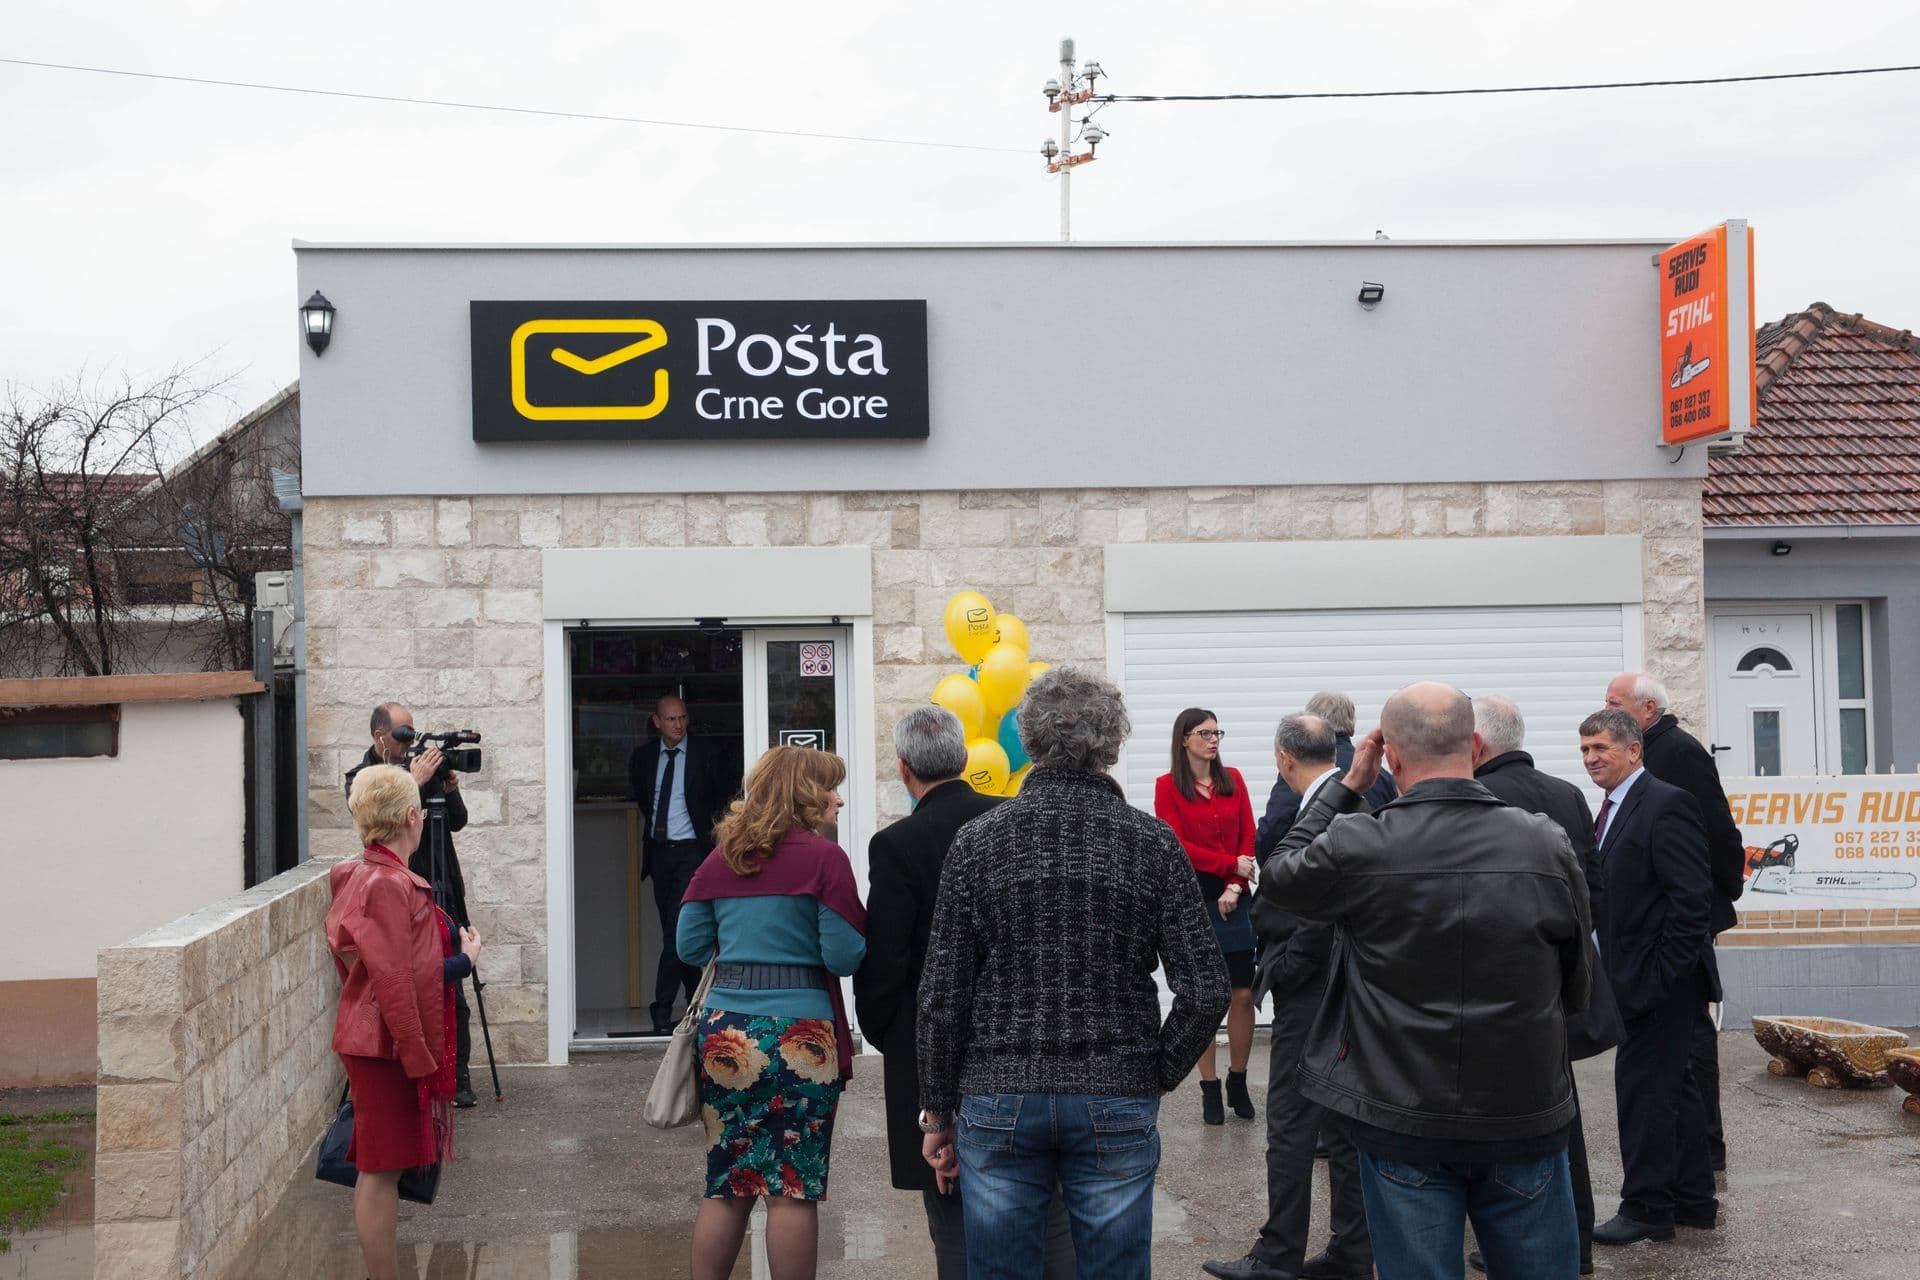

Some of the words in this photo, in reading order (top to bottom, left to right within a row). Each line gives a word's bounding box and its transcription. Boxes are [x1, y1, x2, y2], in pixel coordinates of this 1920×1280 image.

[1668, 243, 1707, 278] SERVIS
[1674, 269, 1700, 297] RUDI
[1666, 295, 1713, 337] STIHL
[696, 318, 889, 376] Pošta
[696, 388, 784, 420] Crne
[796, 388, 888, 419] Gore
[1728, 792, 1847, 825] SERVIS
[1834, 831, 1864, 844] 067
[1870, 831, 1900, 843] 227
[1835, 846, 1865, 859] 068
[1870, 846, 1900, 858] 400
[1816, 876, 1847, 885] STIHL
